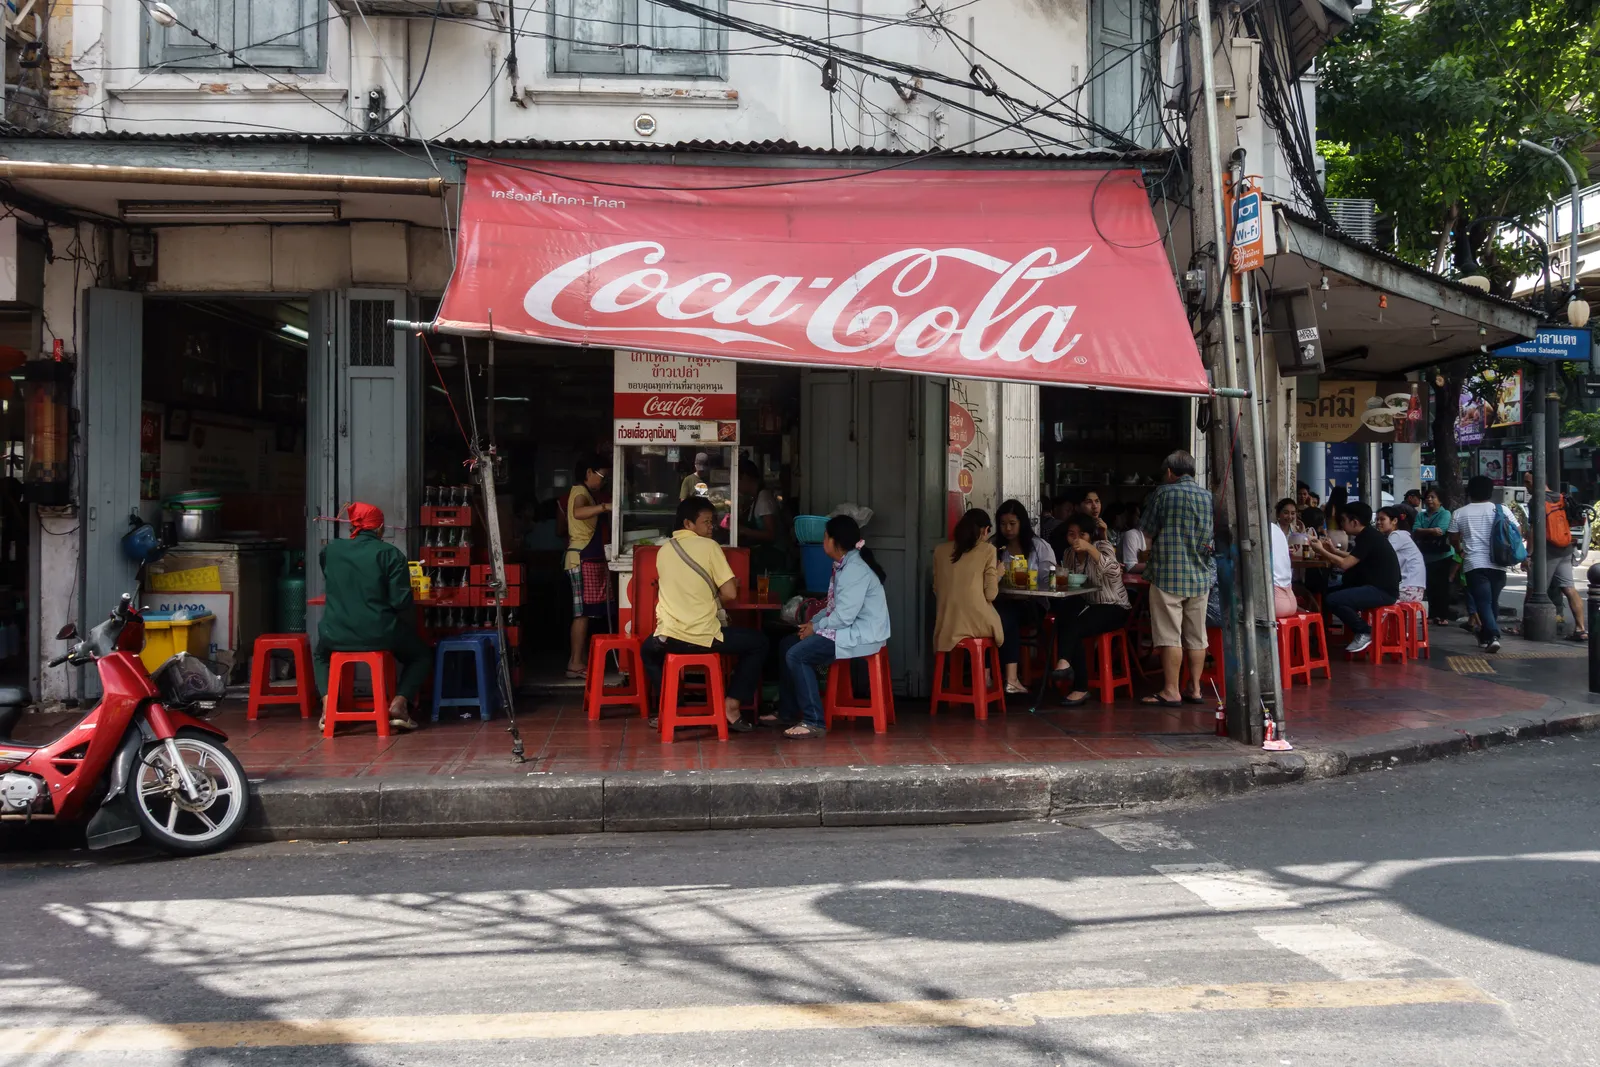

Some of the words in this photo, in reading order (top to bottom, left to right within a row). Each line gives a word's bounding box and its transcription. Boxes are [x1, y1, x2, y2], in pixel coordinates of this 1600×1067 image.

[523, 240, 1092, 365] Coca-Cola
[1515, 345, 1537, 353] Thanon
[1538, 347, 1568, 356] Saladaeng
[652, 364, 699, 378] ข้าวเปล่า
[643, 396, 707, 417] Coca-Cola
